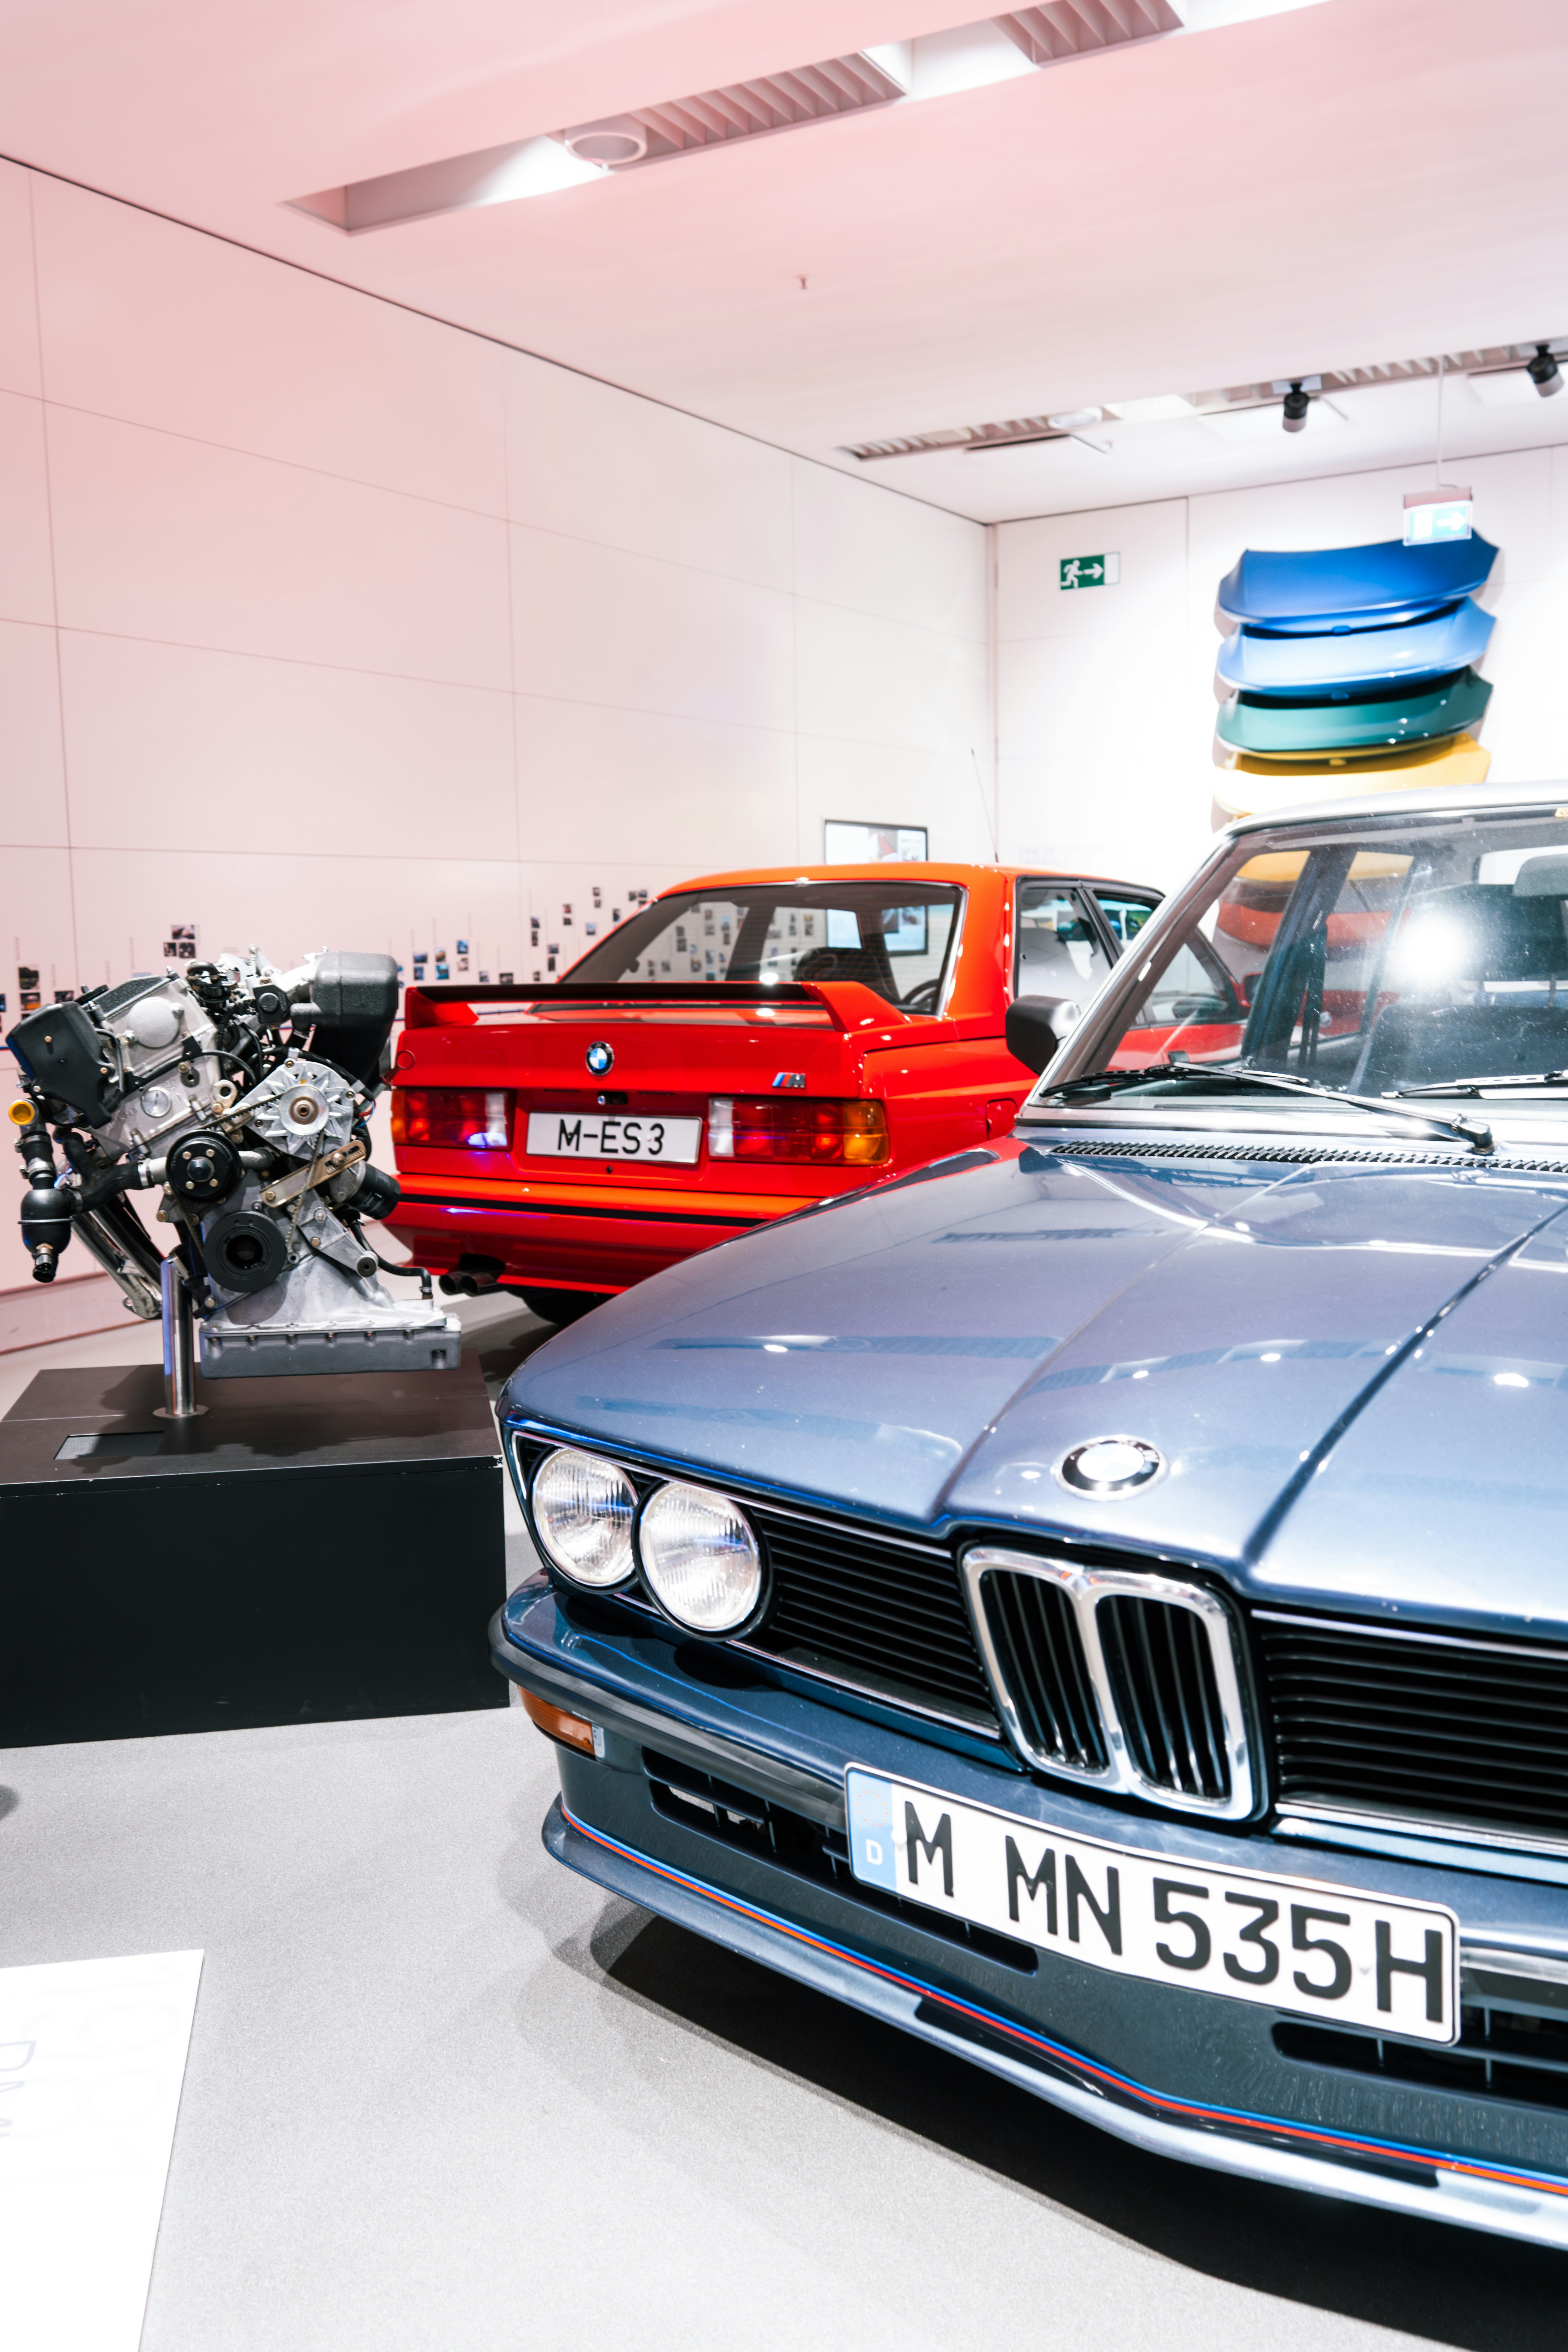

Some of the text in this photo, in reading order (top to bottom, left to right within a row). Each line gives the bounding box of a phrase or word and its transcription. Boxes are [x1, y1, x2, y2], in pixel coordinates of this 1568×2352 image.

[558, 1119, 664, 1155] M-ES3
[866, 1839, 883, 1865] D
[905, 1800, 1443, 2023] M MN 535H
